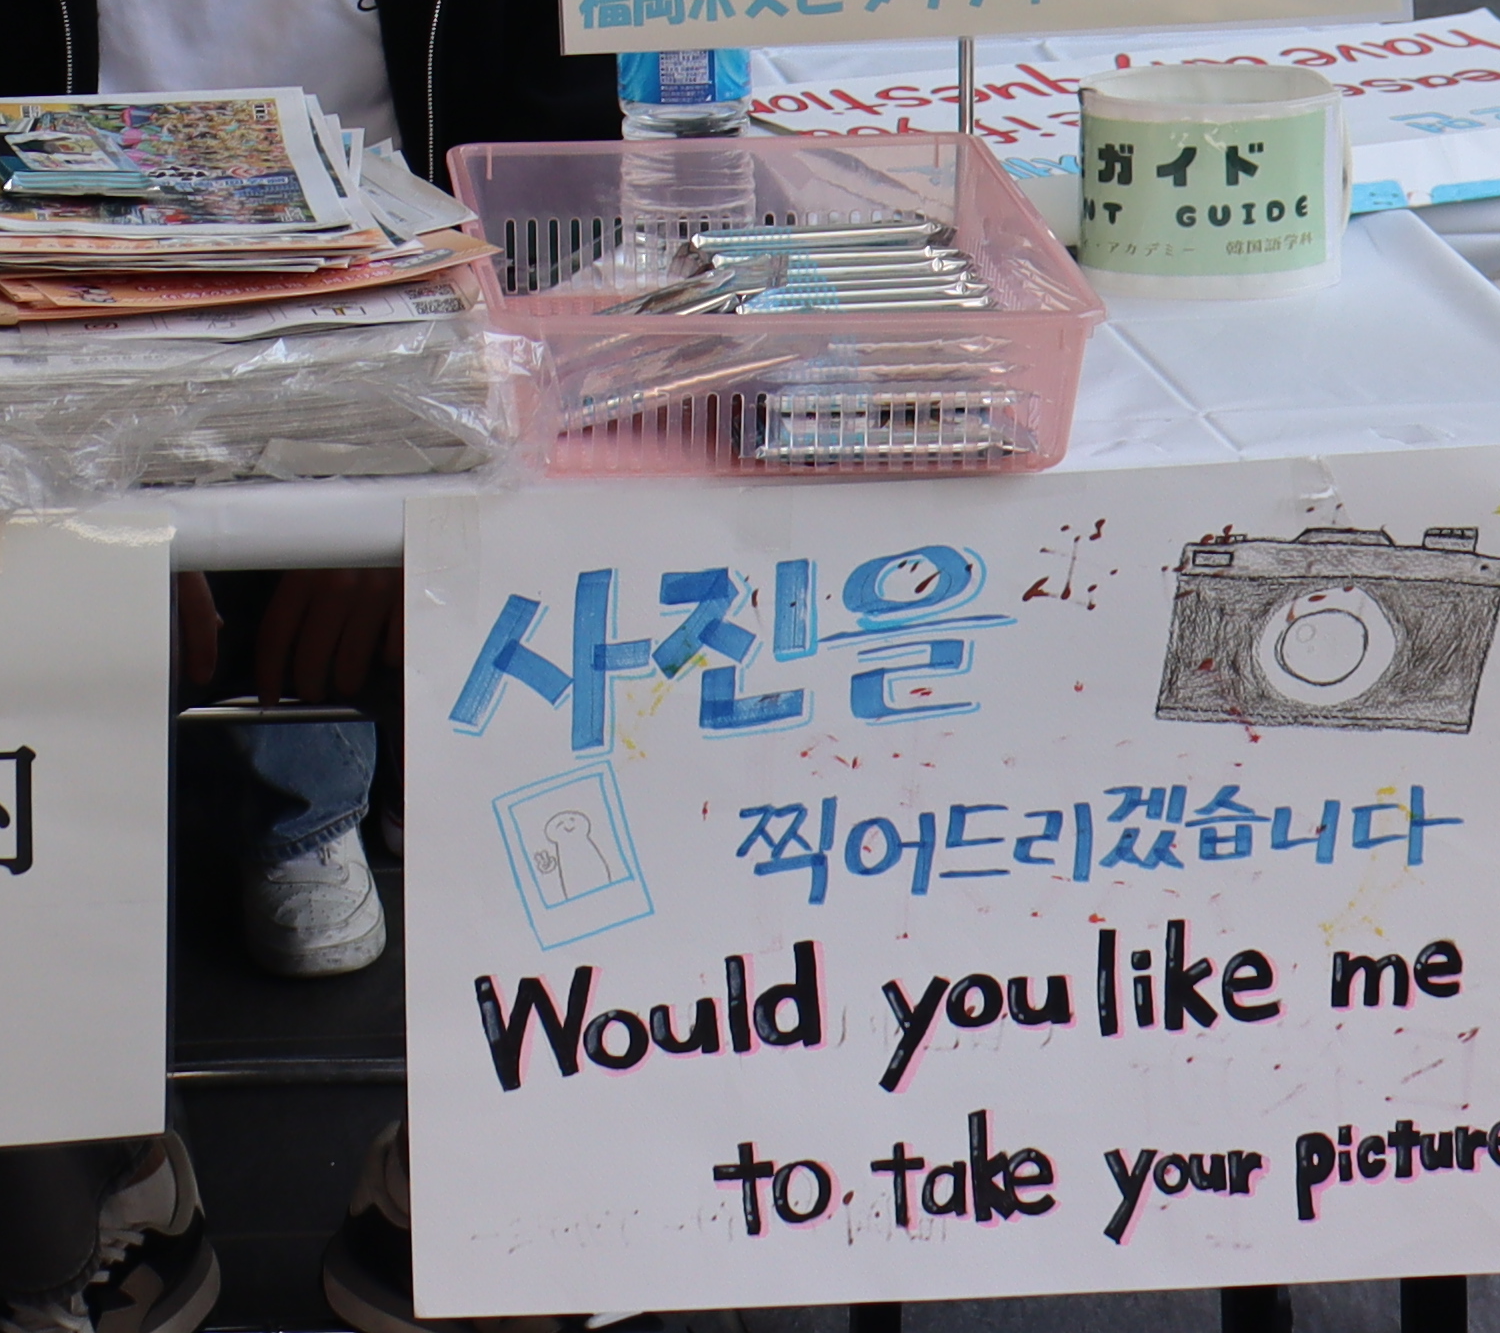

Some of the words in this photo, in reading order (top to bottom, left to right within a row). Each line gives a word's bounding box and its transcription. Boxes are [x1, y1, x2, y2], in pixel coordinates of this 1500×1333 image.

[1083, 141, 1265, 188] ガイド
[1175, 194, 1309, 228] GUIDE
[1225, 230, 1314, 257] 韓国語学科
[446, 542, 1020, 757] 사진을
[733, 780, 1467, 905] 찍어드리겠습니다
[473, 940, 827, 1094] Would
[877, 965, 1075, 1094] you
[1094, 918, 1280, 1039] like
[1329, 936, 1467, 1016] me
[870, 1108, 1057, 1229] take
[1102, 1131, 1267, 1246] your
